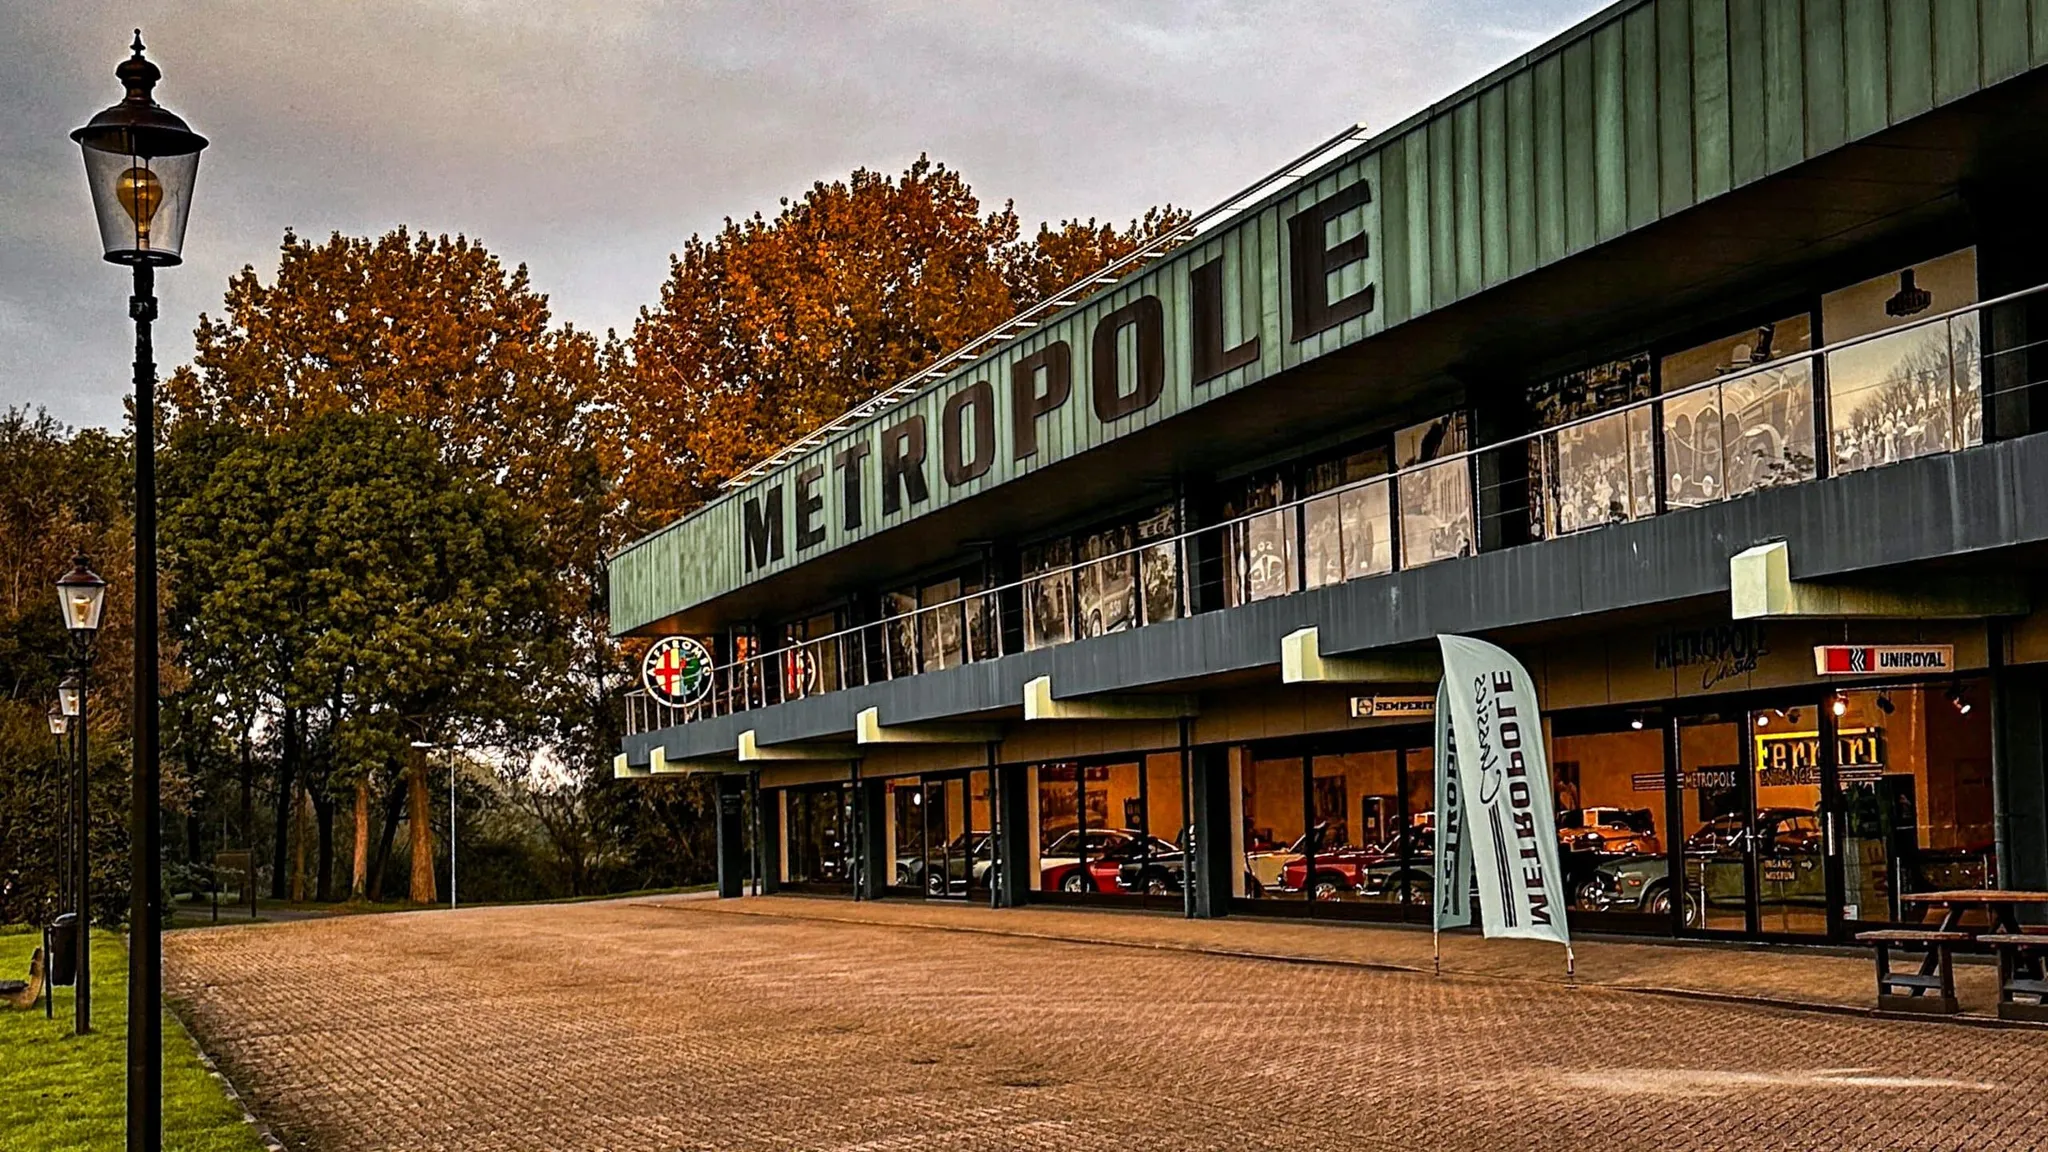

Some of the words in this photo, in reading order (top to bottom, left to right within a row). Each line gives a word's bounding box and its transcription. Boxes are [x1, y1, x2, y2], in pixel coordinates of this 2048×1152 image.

[743, 178, 1374, 574] METROPOLE
[1655, 624, 1771, 670] METROPOLE
[1879, 652, 1946, 668] UNIROYAL
[1375, 701, 1435, 711] SEMPERIT
[1755, 727, 1878, 771] Ferrri
[1685, 770, 1737, 788] METROPOLE
[1764, 871, 1796, 881] MUSEUM
